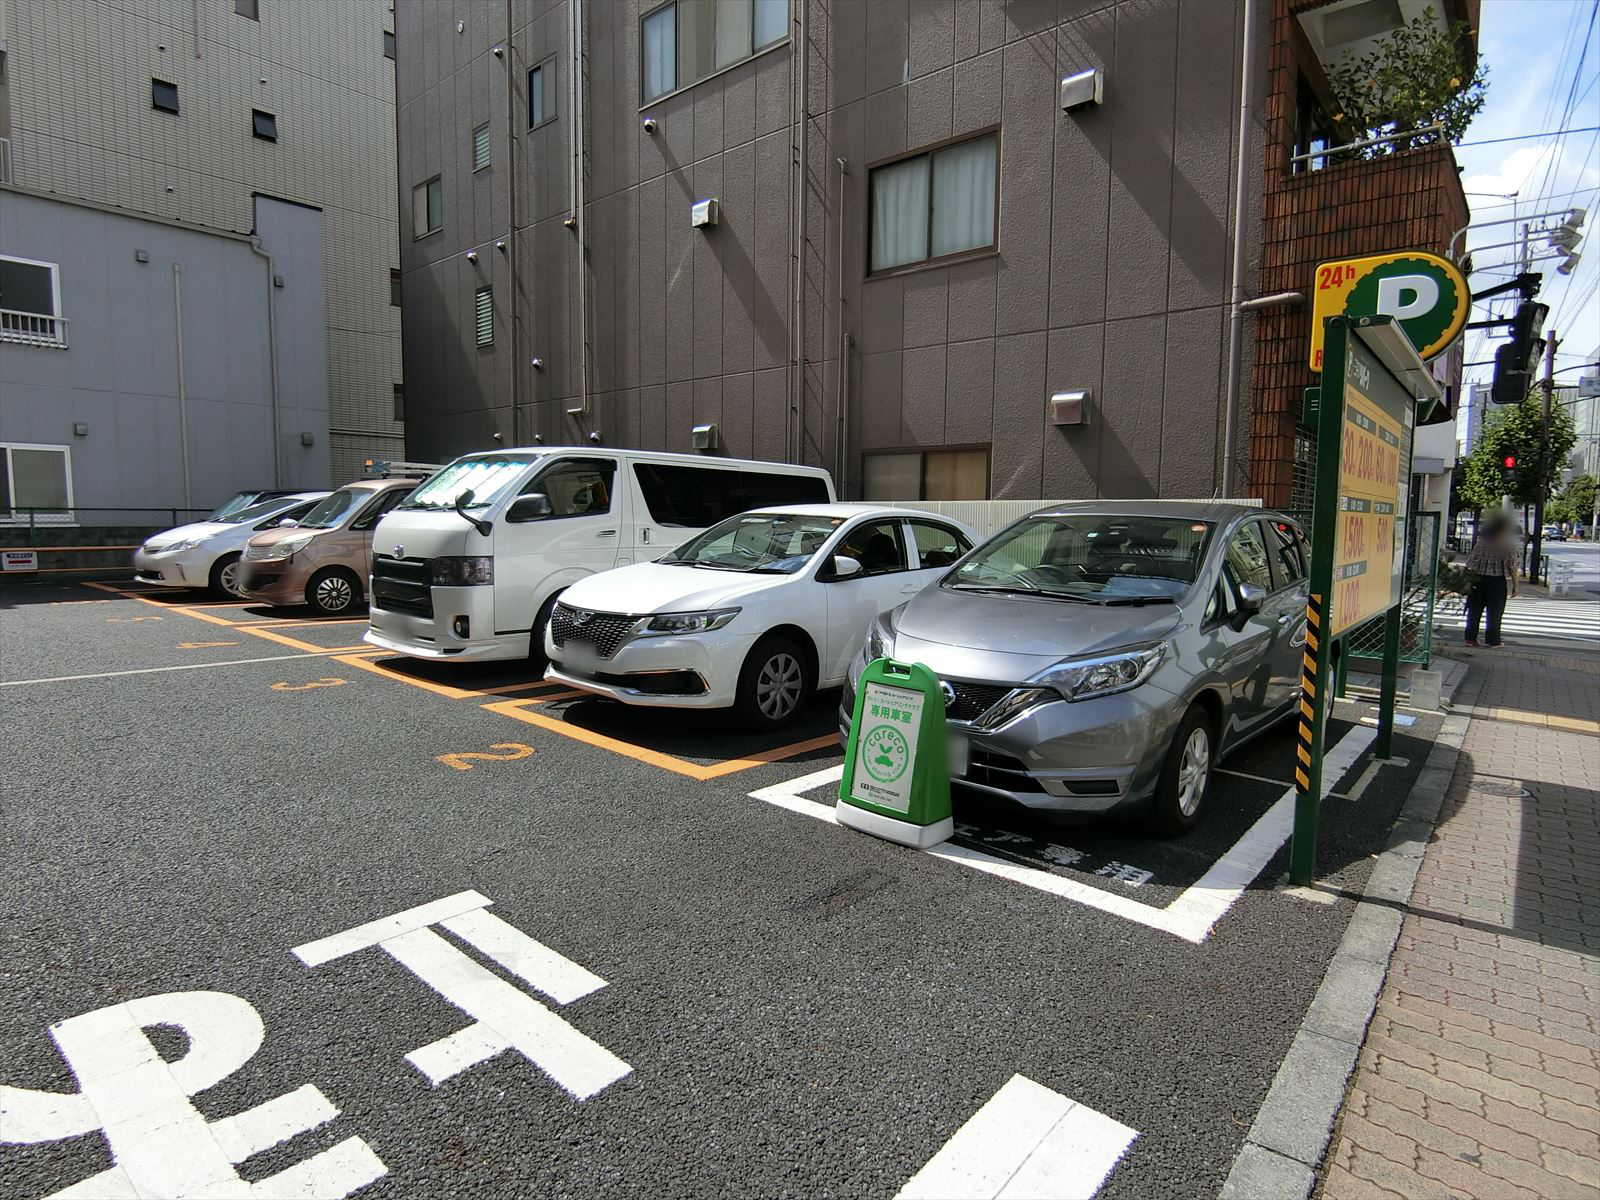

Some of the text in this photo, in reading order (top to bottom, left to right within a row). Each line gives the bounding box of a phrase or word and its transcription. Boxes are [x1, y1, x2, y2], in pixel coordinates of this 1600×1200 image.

[1319, 265, 1355, 290] 24h
[1377, 274, 1440, 321] P
[271, 677, 347, 692] 3
[870, 704, 913, 724] 専用車室
[868, 729, 904, 754] careco
[434, 742, 536, 771] 2
